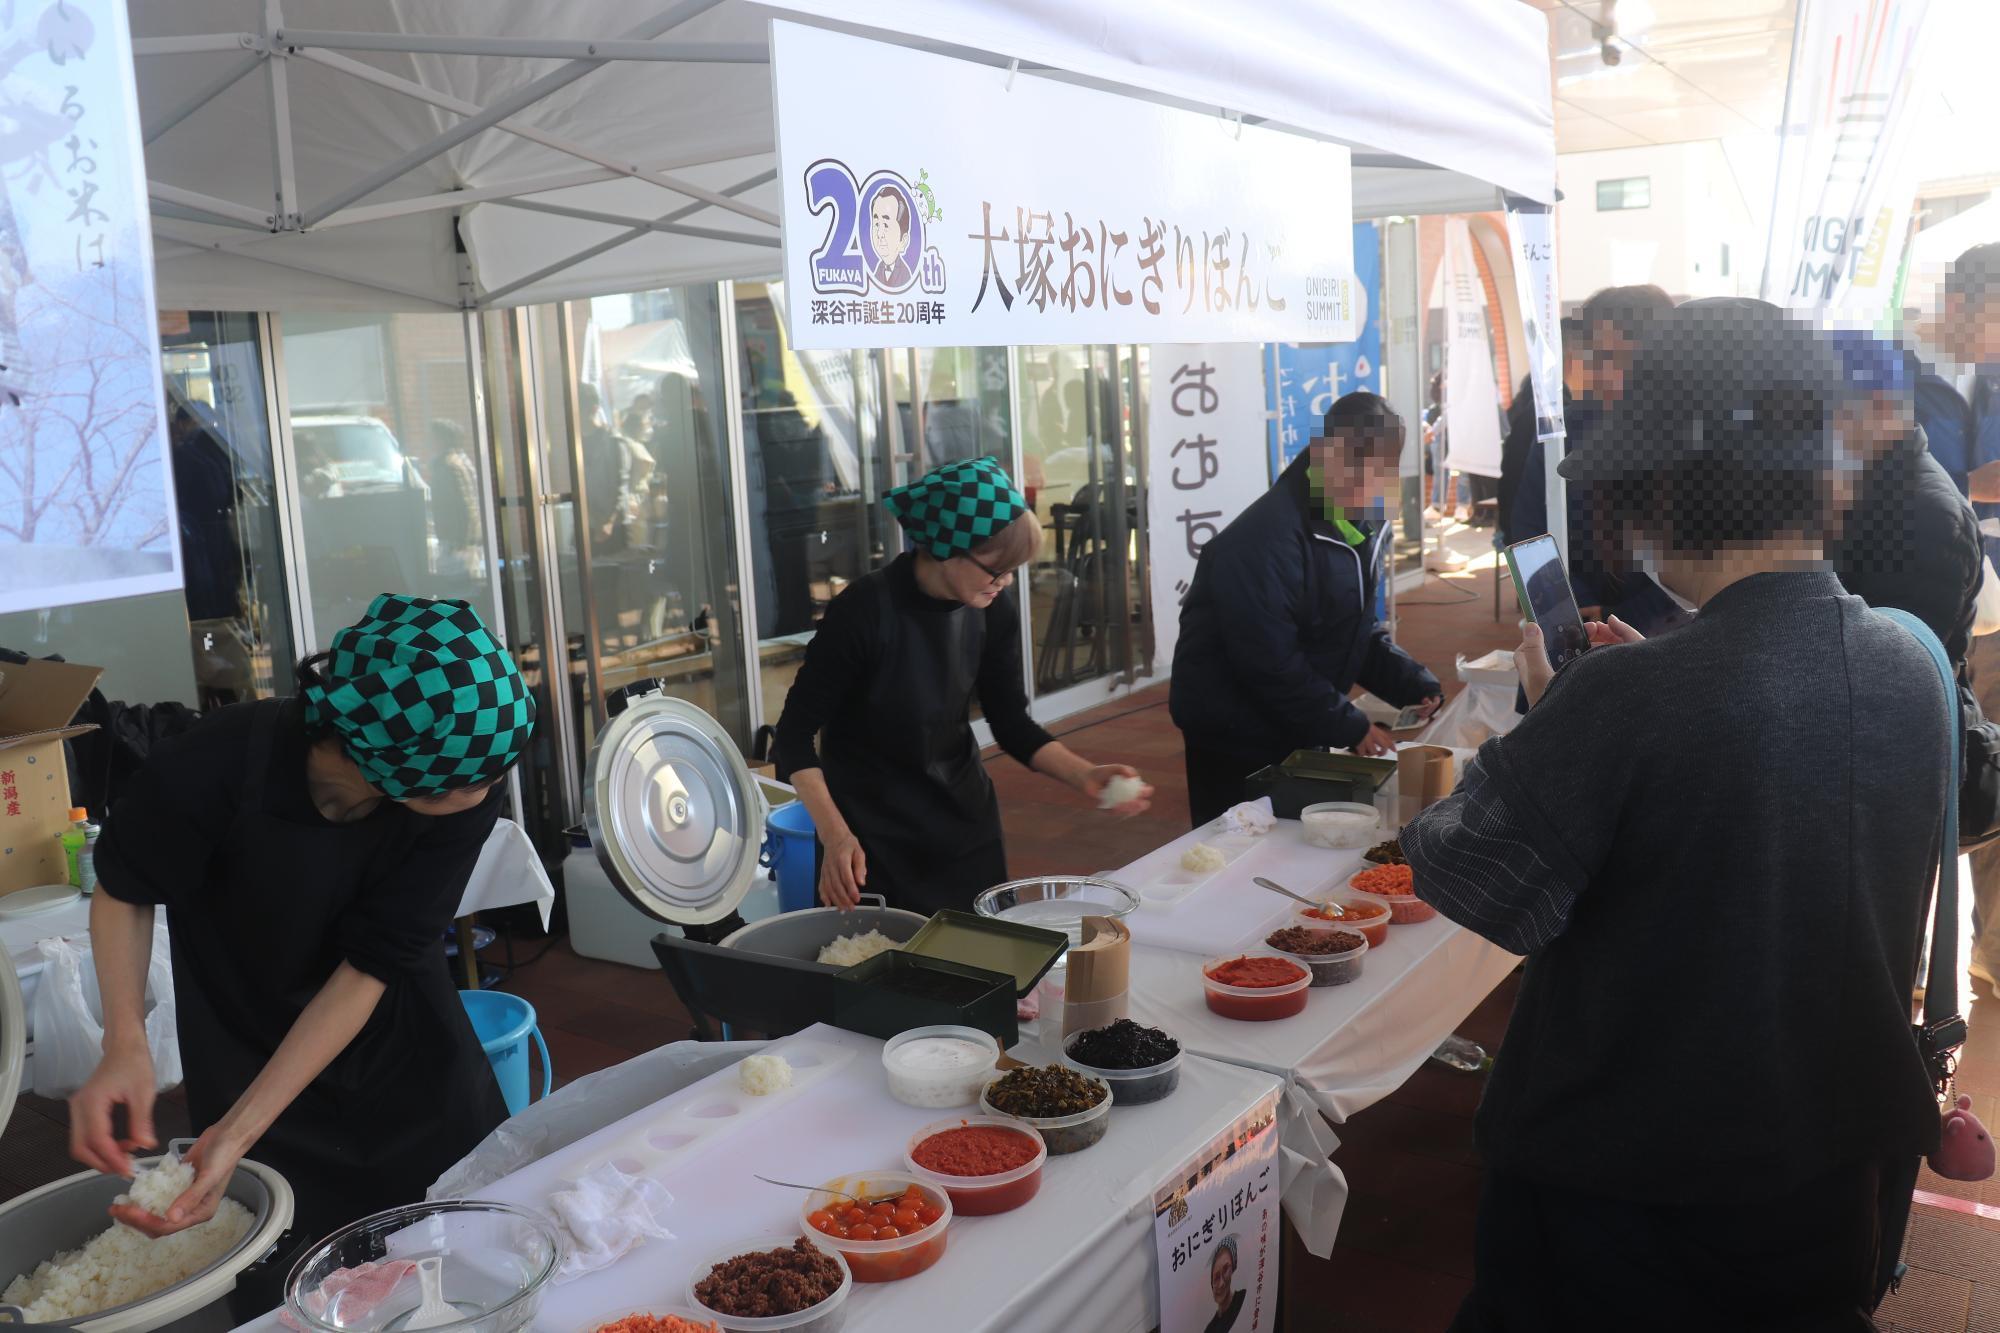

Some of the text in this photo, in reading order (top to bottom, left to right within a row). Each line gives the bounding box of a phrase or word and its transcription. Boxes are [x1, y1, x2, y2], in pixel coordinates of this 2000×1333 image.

[818, 268, 863, 284] FUKAYA
[1305, 277, 1341, 297] ONIGIRI
[811, 300, 946, 326] 深谷市誕生20周年
[1306, 301, 1341, 321] SUMMIT
[1, 770, 21, 817] 新潟産
[1171, 1166, 1270, 1273] おにぎりぼんご
